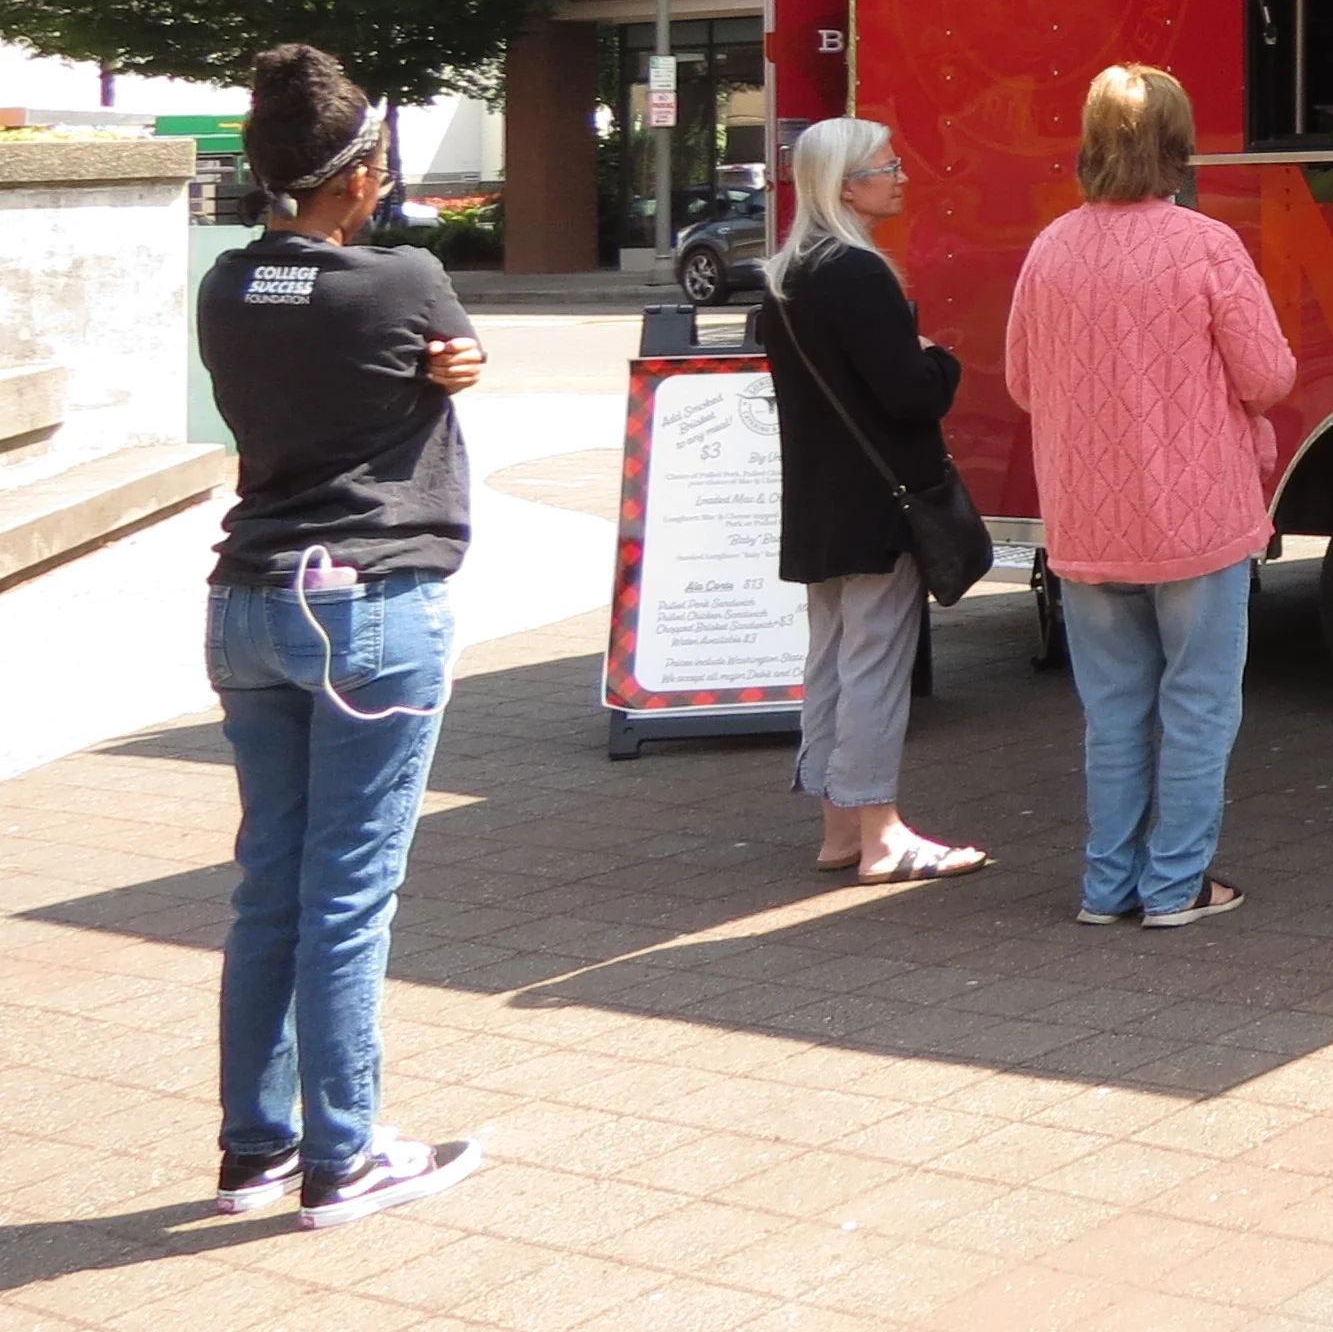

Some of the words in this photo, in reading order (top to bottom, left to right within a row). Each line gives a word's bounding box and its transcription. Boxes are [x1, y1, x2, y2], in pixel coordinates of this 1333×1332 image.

[254, 266, 319, 280] COLLEGE
[247, 280, 314, 295] SUCCESS
[244, 293, 311, 305] FOUNDATION
[700, 441, 722, 461] $3
[711, 598, 756, 609] Sandwich
[687, 611, 722, 622] Chicken
[724, 609, 768, 620] Sandwich
[656, 624, 694, 635] Chopped
[727, 655, 779, 667] Washington
